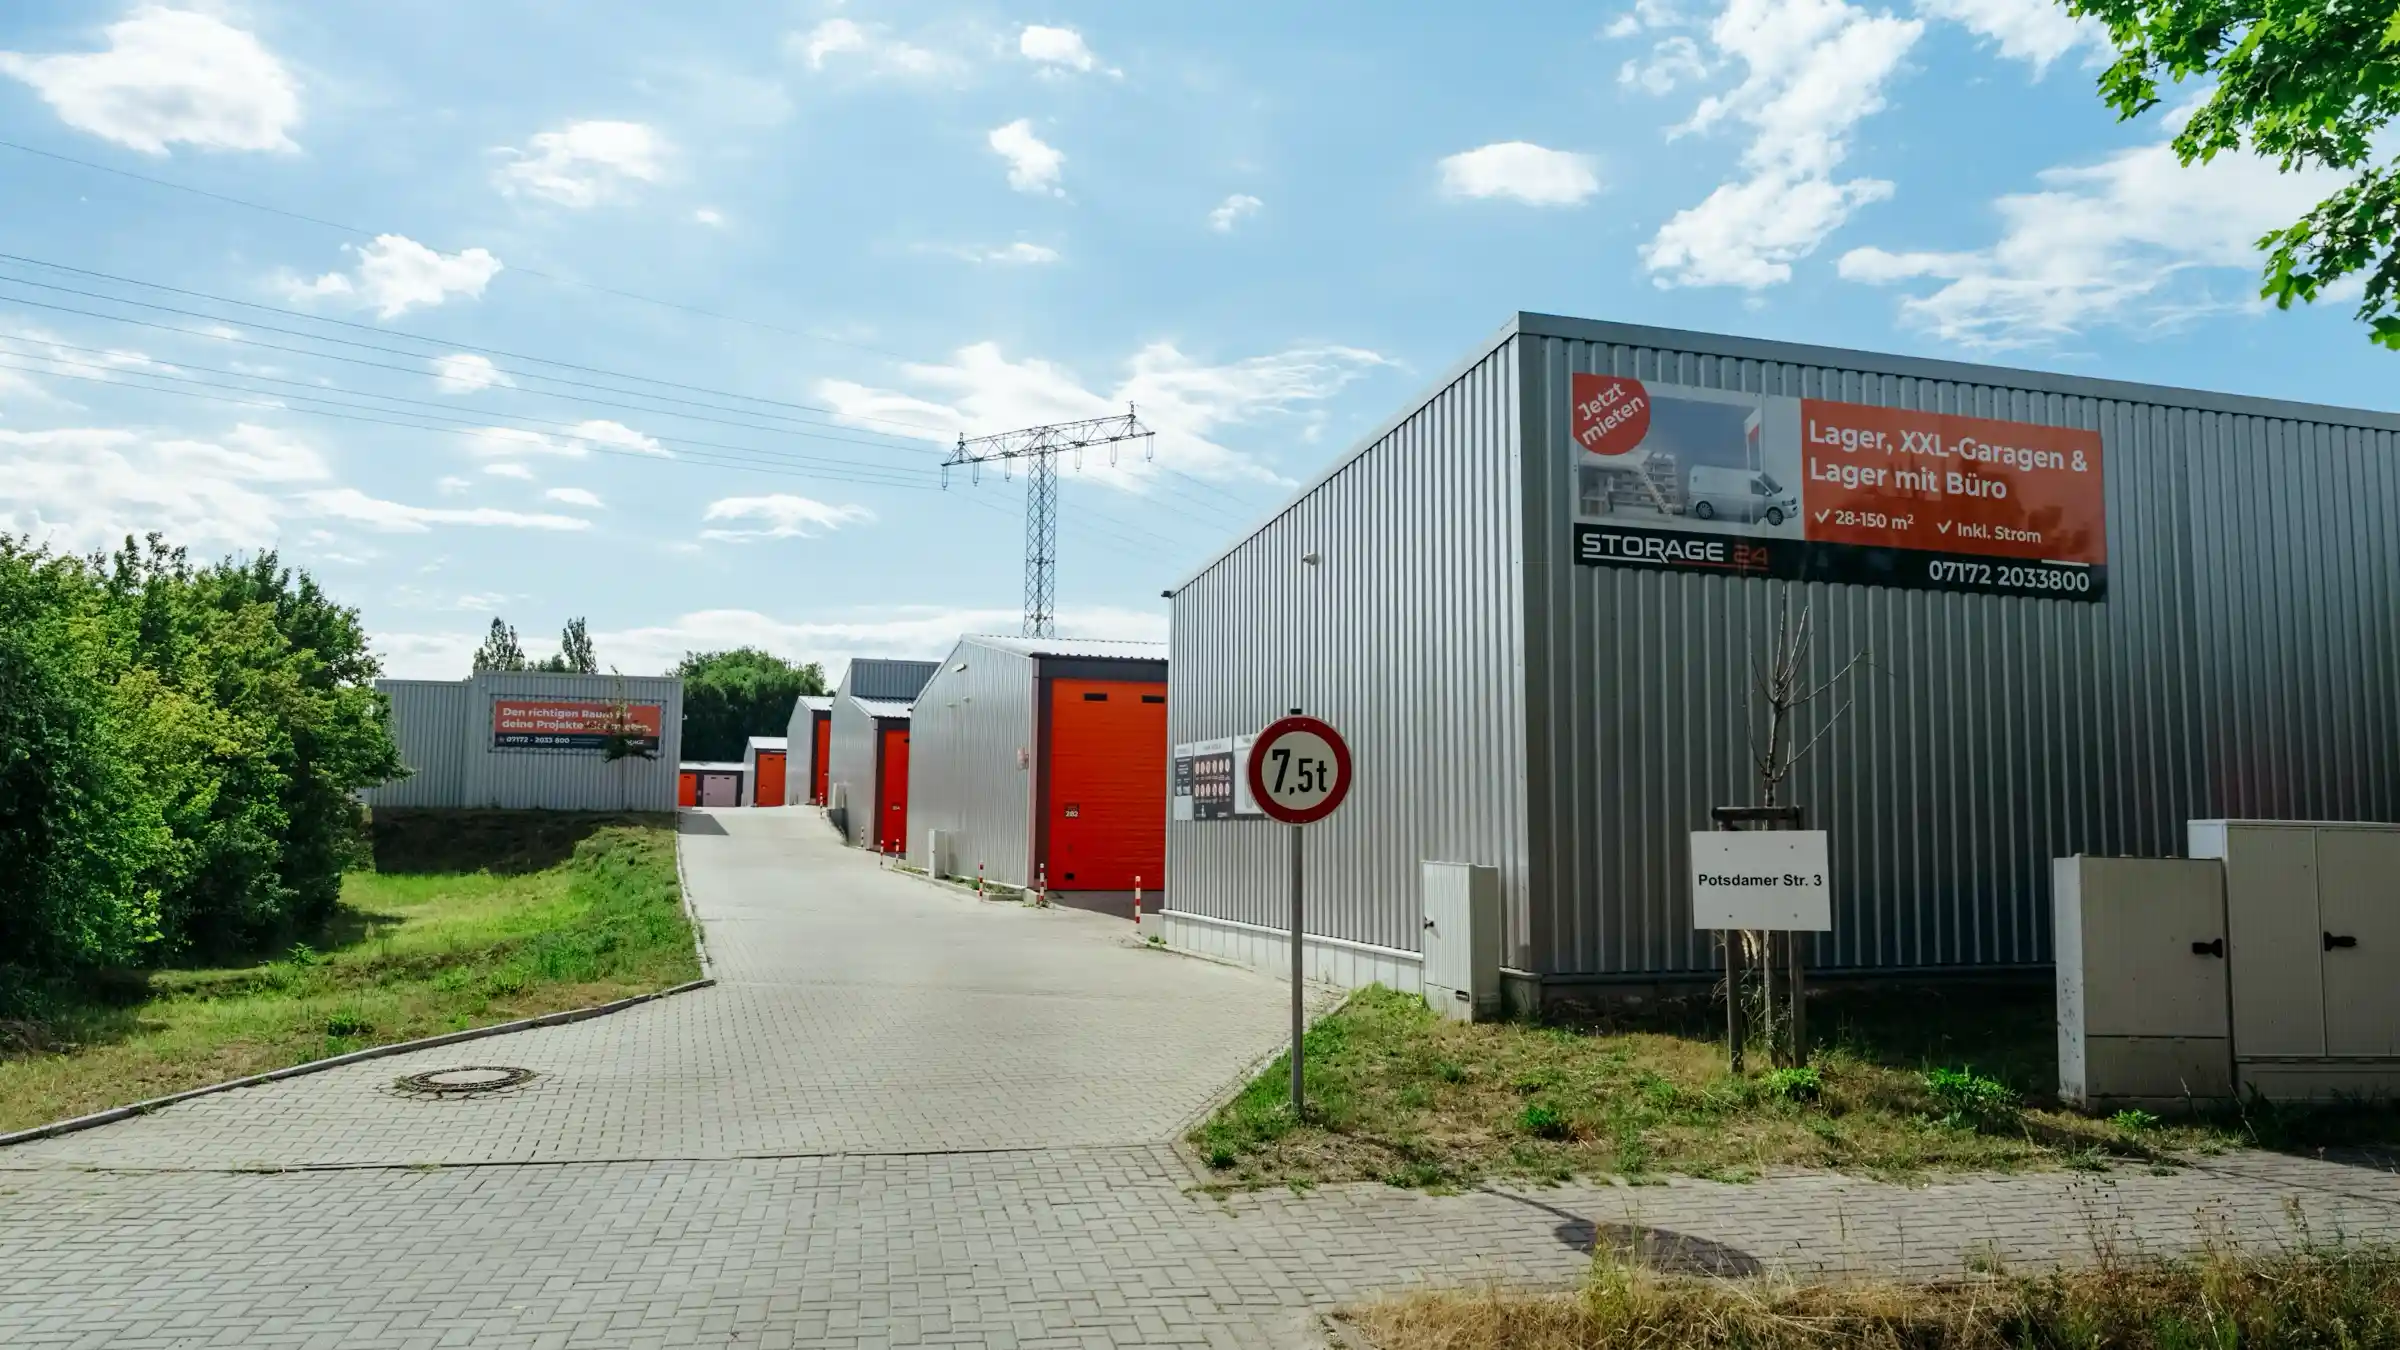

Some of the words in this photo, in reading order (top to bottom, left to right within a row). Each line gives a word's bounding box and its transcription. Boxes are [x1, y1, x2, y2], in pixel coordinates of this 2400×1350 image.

[1578, 383, 1626, 420] Jetzt
[1582, 397, 1645, 445] mieten
[1809, 419, 1893, 454] Lager,
[1900, 430, 2064, 471] XXL-Garagen
[2071, 450, 2088, 472] &
[1810, 457, 1886, 489] Lager
[1895, 466, 1939, 493] mit
[1946, 471, 2007, 499] Büro
[1835, 510, 1887, 528] 28-150
[1957, 522, 1991, 540] Inkl.
[1995, 525, 2042, 544] Strom
[1582, 533, 1724, 563] STORAGE
[1733, 544, 1769, 565] 24
[1929, 560, 1991, 585] 07172
[1997, 565, 2090, 592] 2033800
[502, 719, 534, 728] deine
[537, 720, 584, 731] Projekte
[503, 708, 525, 716] Den
[528, 707, 579, 719] richtigen
[1272, 749, 1327, 795] 7,5t
[1698, 874, 1778, 886] Potsdamer
[1783, 874, 1808, 886] Str.
[1813, 874, 1822, 886] 3
